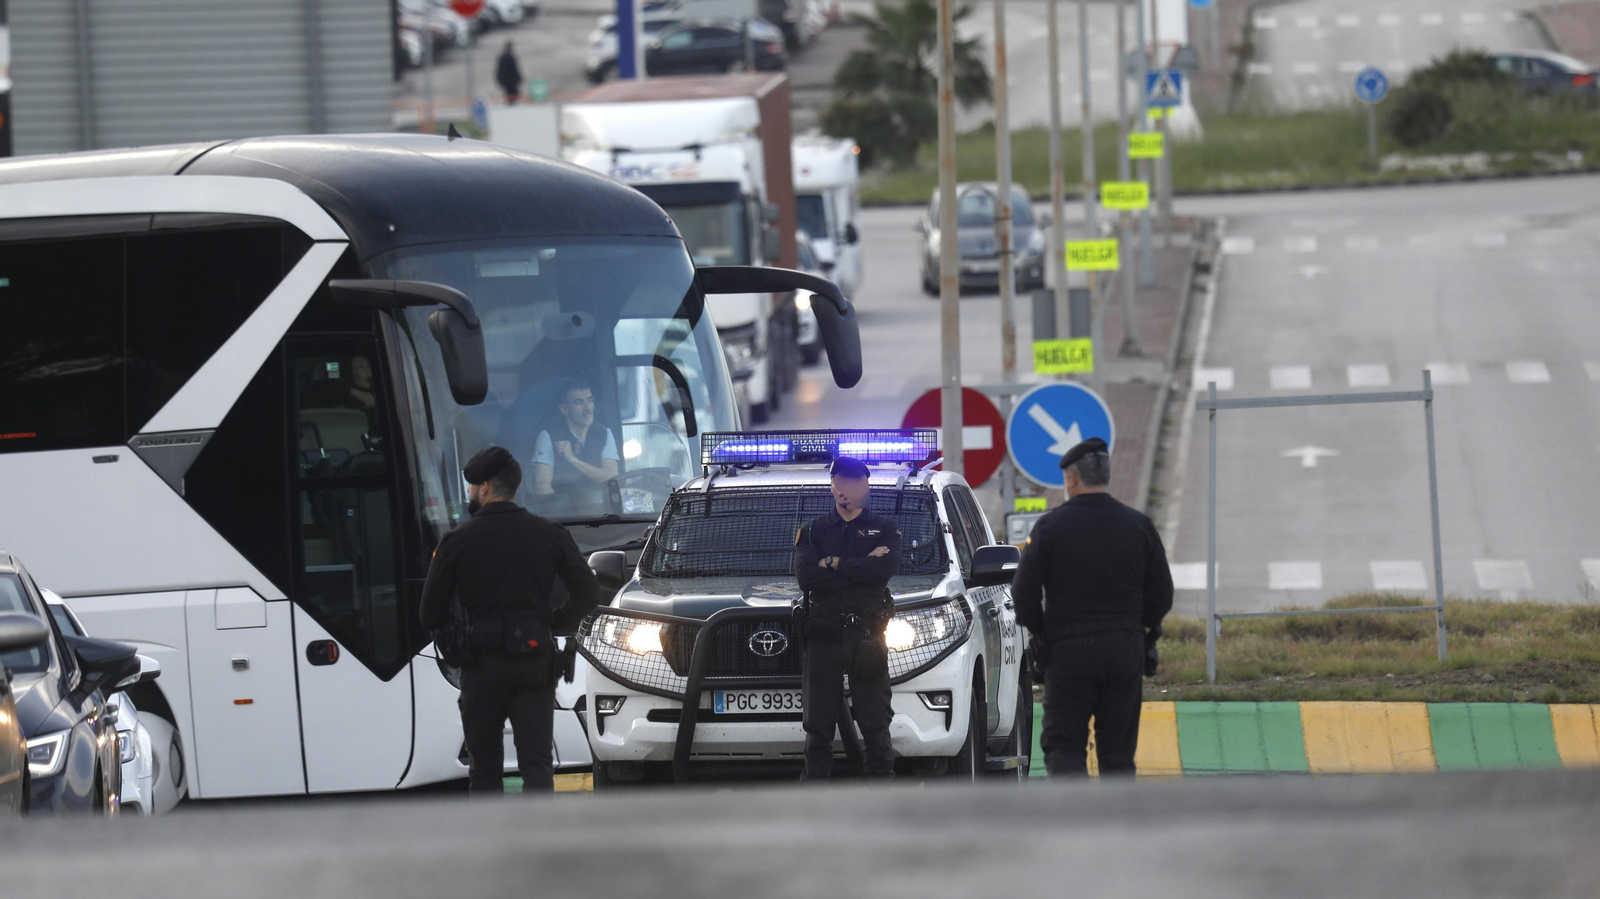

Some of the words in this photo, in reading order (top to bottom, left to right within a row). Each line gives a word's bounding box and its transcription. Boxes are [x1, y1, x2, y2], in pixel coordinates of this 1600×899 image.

[138, 436, 202, 448] TOURLINER
[725, 693, 758, 711] PGC
[761, 692, 804, 710] 9933
